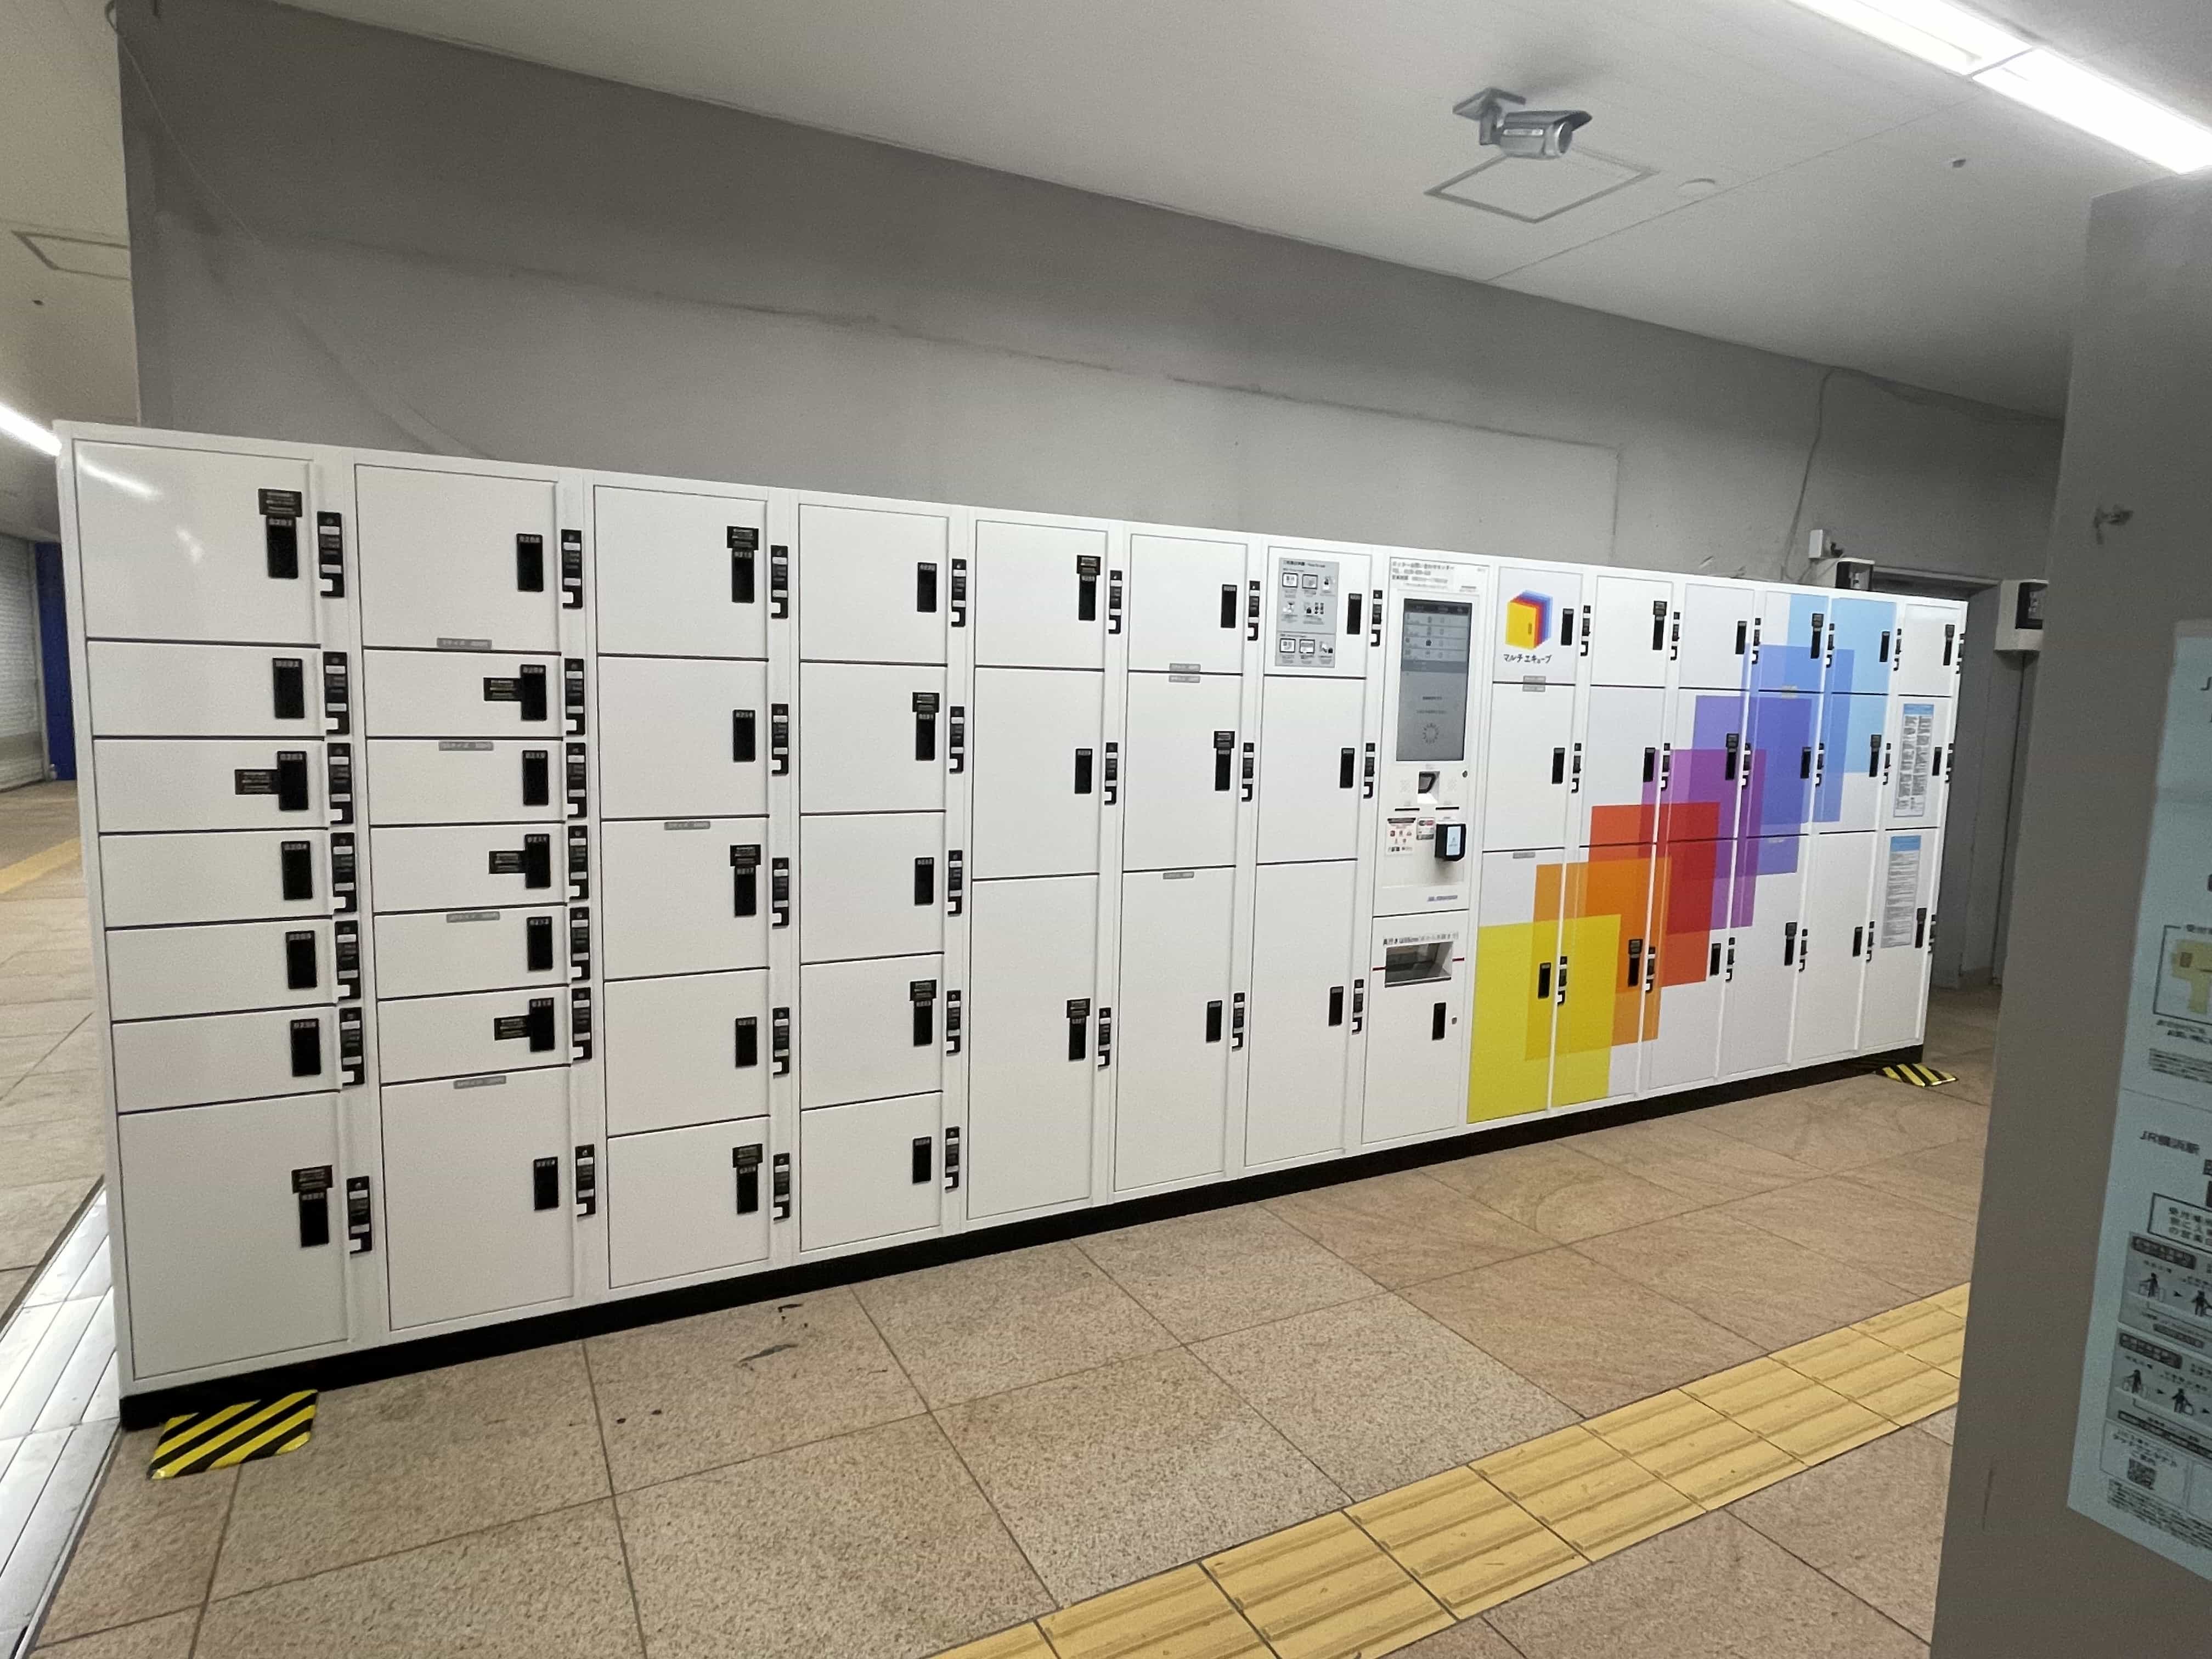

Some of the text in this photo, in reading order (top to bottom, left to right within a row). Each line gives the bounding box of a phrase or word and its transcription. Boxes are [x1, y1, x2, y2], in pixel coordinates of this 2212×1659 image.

[1503, 653, 1553, 664] マルチエキューブ
